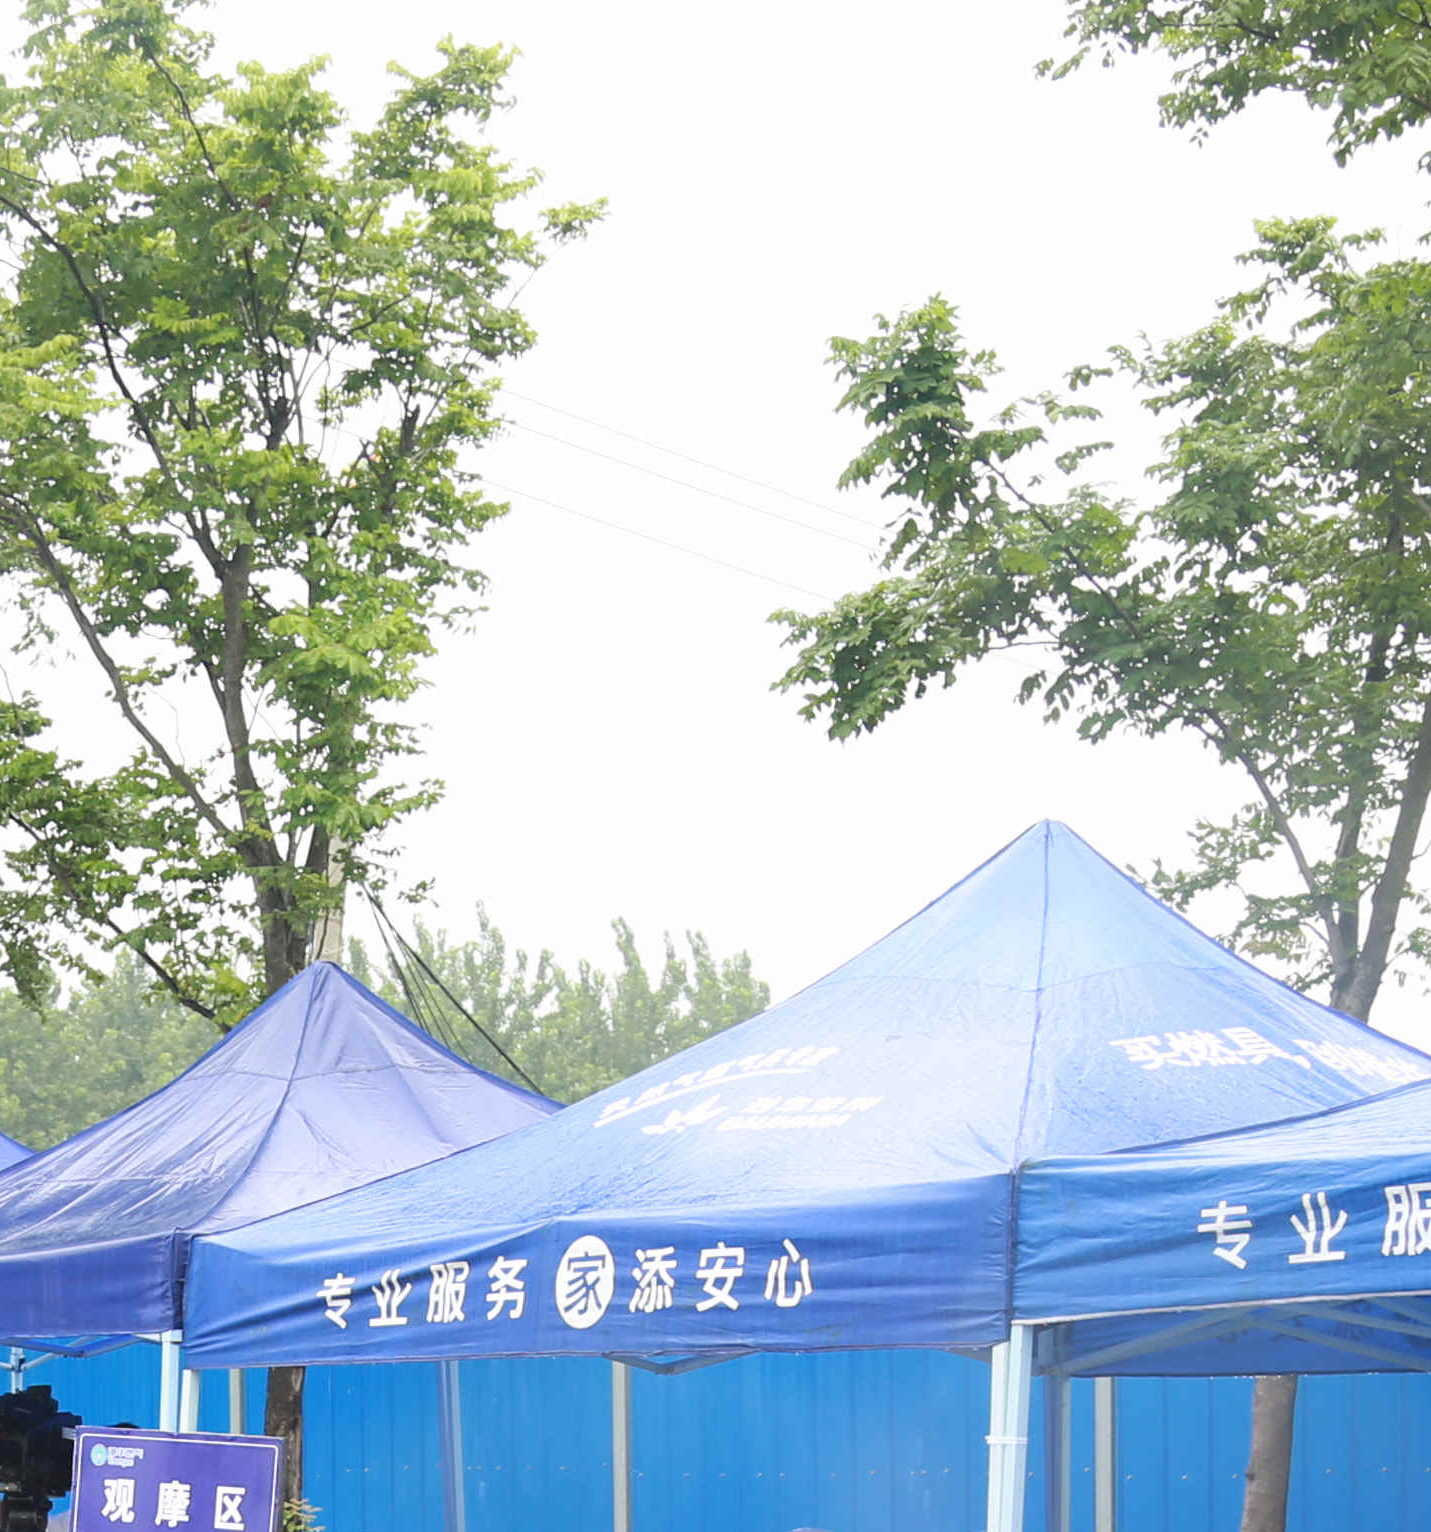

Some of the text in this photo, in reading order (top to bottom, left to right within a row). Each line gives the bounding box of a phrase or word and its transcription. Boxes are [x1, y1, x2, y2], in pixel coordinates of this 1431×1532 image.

[315, 1254, 530, 1331] 专业服务
[100, 1477, 248, 1532] 观摩区
